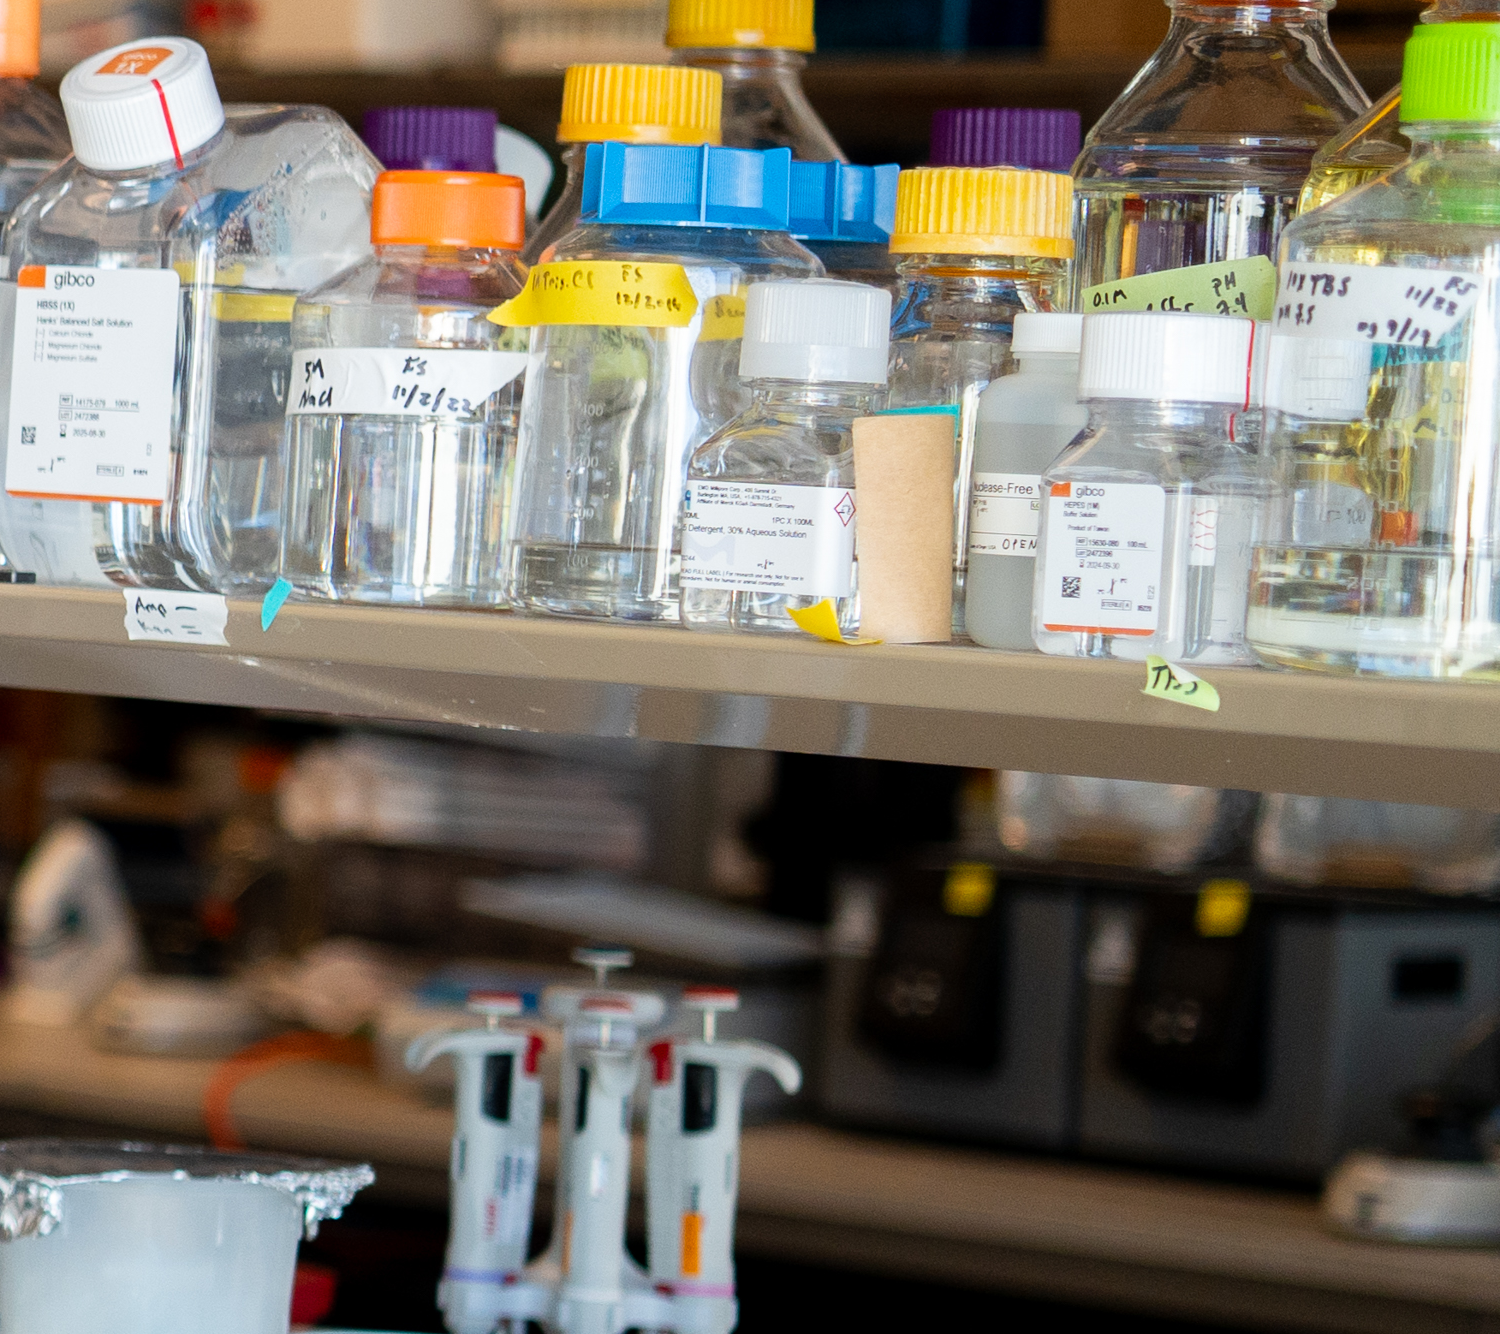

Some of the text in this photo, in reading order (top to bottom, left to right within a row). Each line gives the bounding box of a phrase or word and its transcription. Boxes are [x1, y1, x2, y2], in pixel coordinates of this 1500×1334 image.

[54, 271, 95, 289] gibco
[1075, 486, 1105, 499] gibco
[1064, 501, 1086, 509] HEPES
[745, 527, 777, 539] Aqueous
[779, 529, 807, 539] Solution
